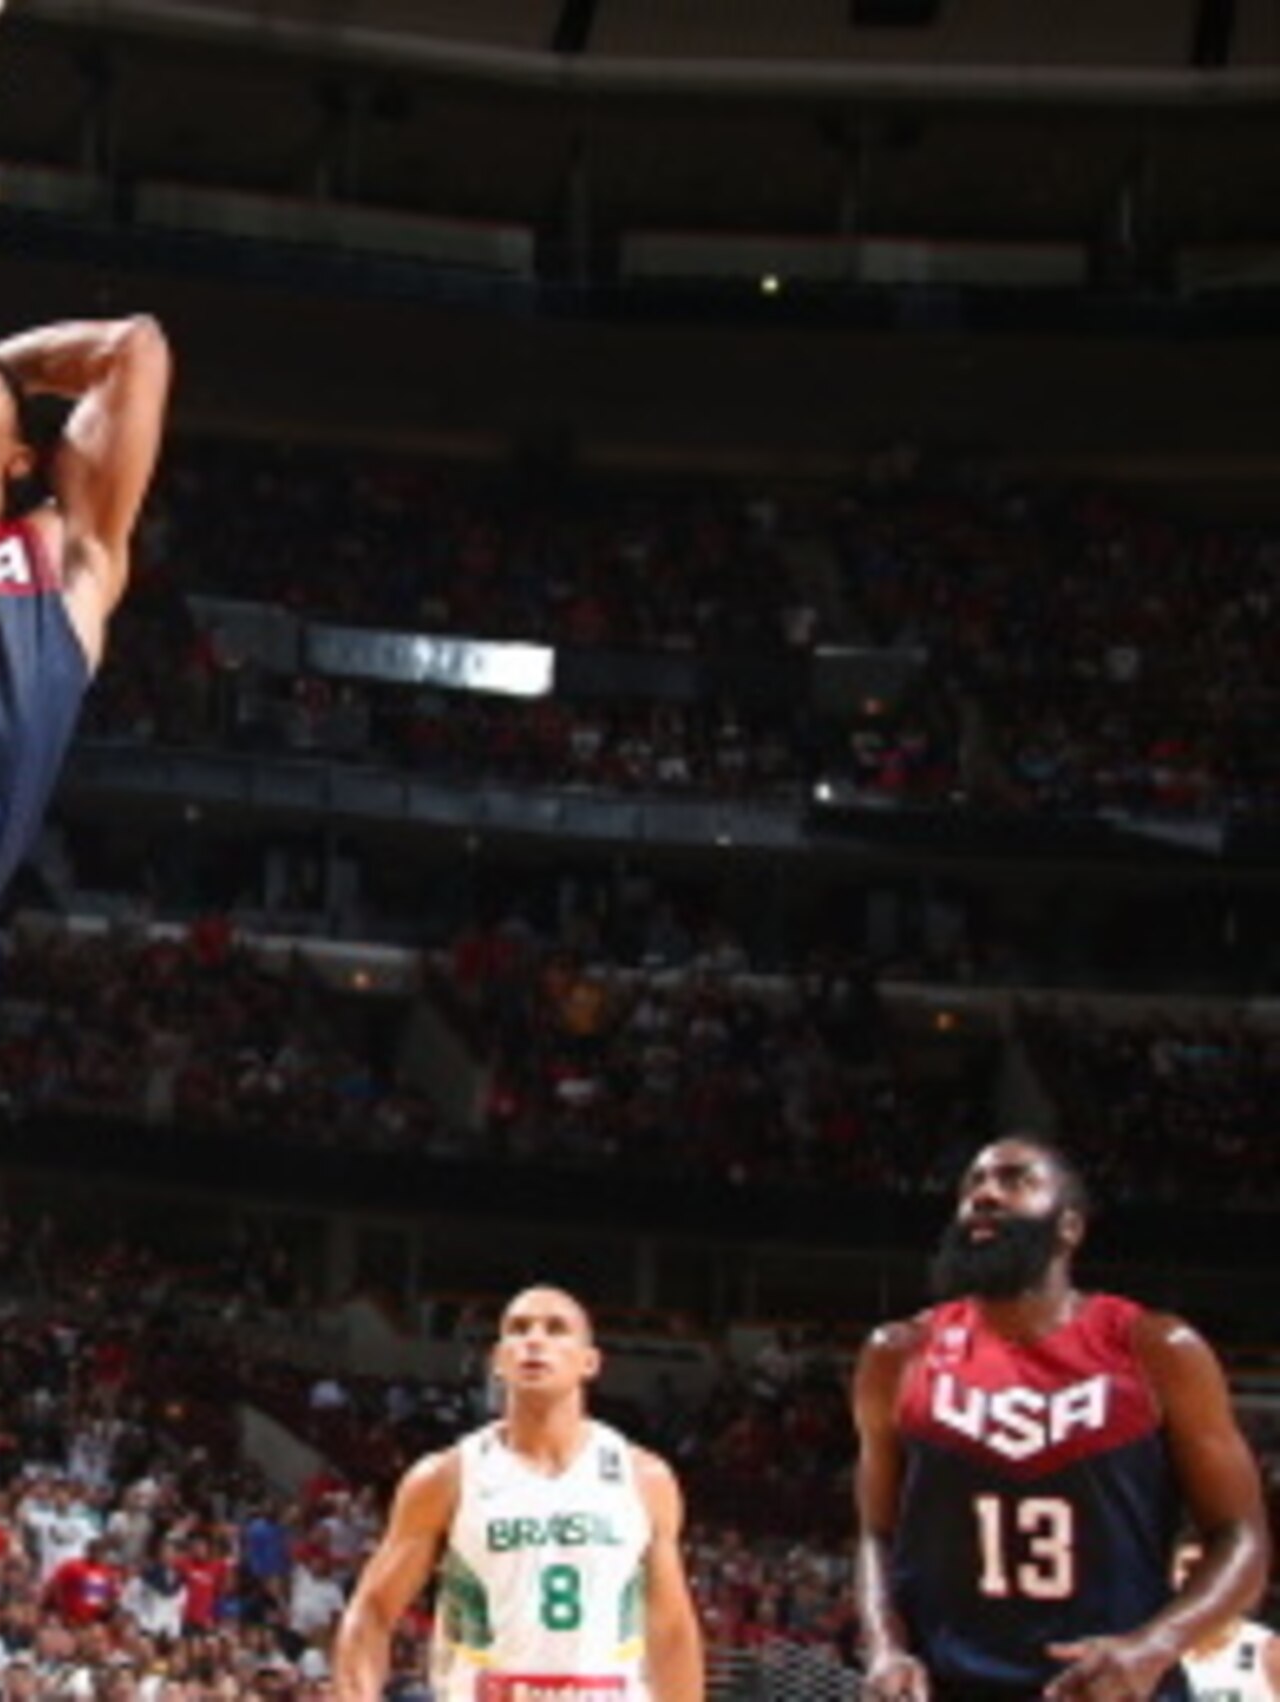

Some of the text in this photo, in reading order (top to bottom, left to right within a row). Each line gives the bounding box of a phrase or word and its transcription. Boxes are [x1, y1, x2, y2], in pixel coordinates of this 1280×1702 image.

[931, 1371, 1110, 1461] USA
[486, 1511, 625, 1552] BRASIL
[974, 1493, 1076, 1600] 13
[538, 1563, 582, 1631] 8
